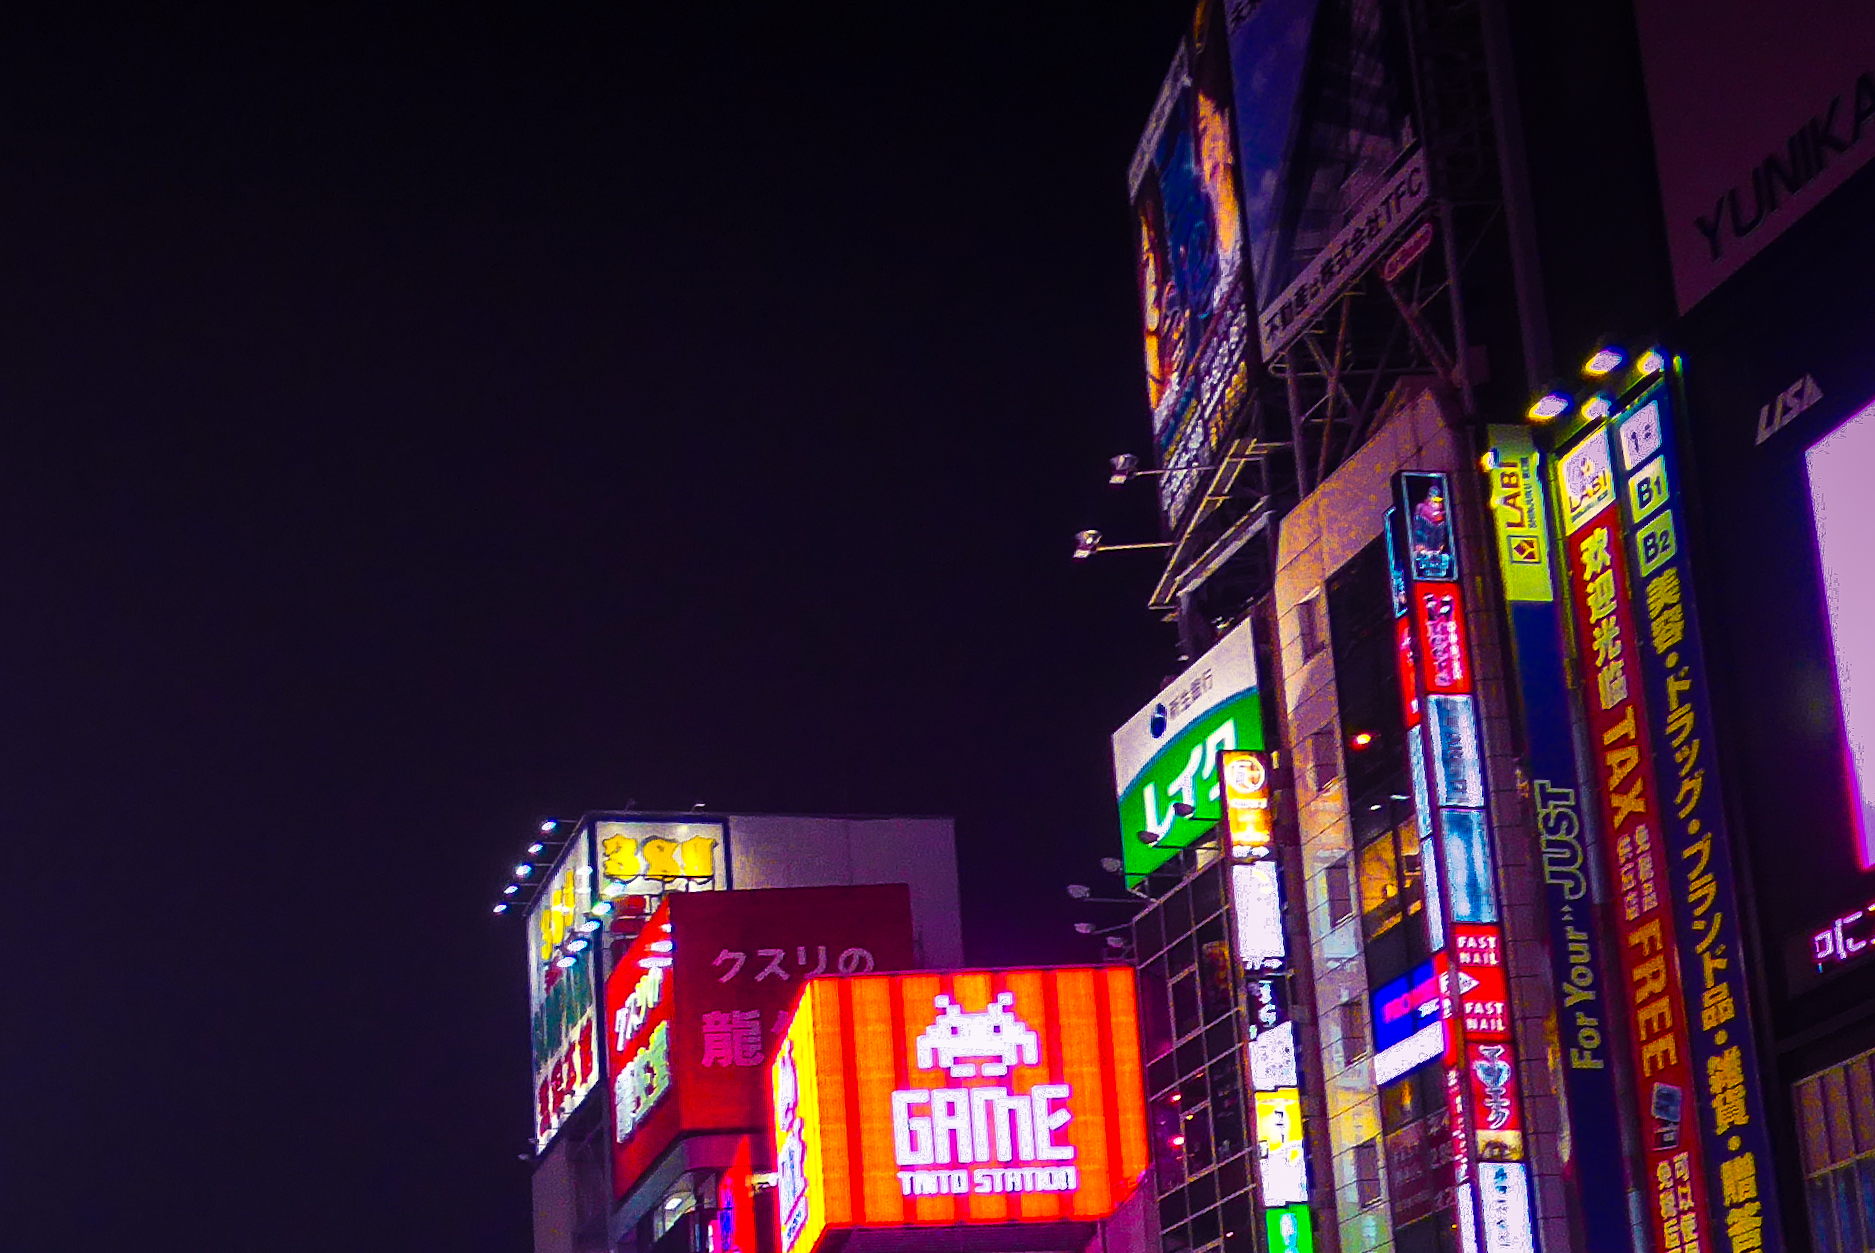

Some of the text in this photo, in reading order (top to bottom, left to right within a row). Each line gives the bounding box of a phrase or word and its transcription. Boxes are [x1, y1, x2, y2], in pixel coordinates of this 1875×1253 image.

[1500, 460, 1527, 529] LABI
[1637, 476, 1664, 509] B1
[1643, 528, 1670, 564] B2
[1143, 717, 1237, 847] レイク
[1604, 705, 1648, 829] TAX
[1458, 935, 1498, 949] FAST
[1459, 951, 1499, 966] NAIL
[712, 946, 874, 983] クスリの
[1564, 926, 1597, 1007] Your
[1464, 1001, 1504, 1016] FAST
[1628, 918, 1679, 1077] FREE
[1466, 1017, 1506, 1032] NAIL
[1570, 1011, 1604, 1070] For
[892, 1084, 1074, 1166] GAME
[974, 1167, 1076, 1194] STATION
